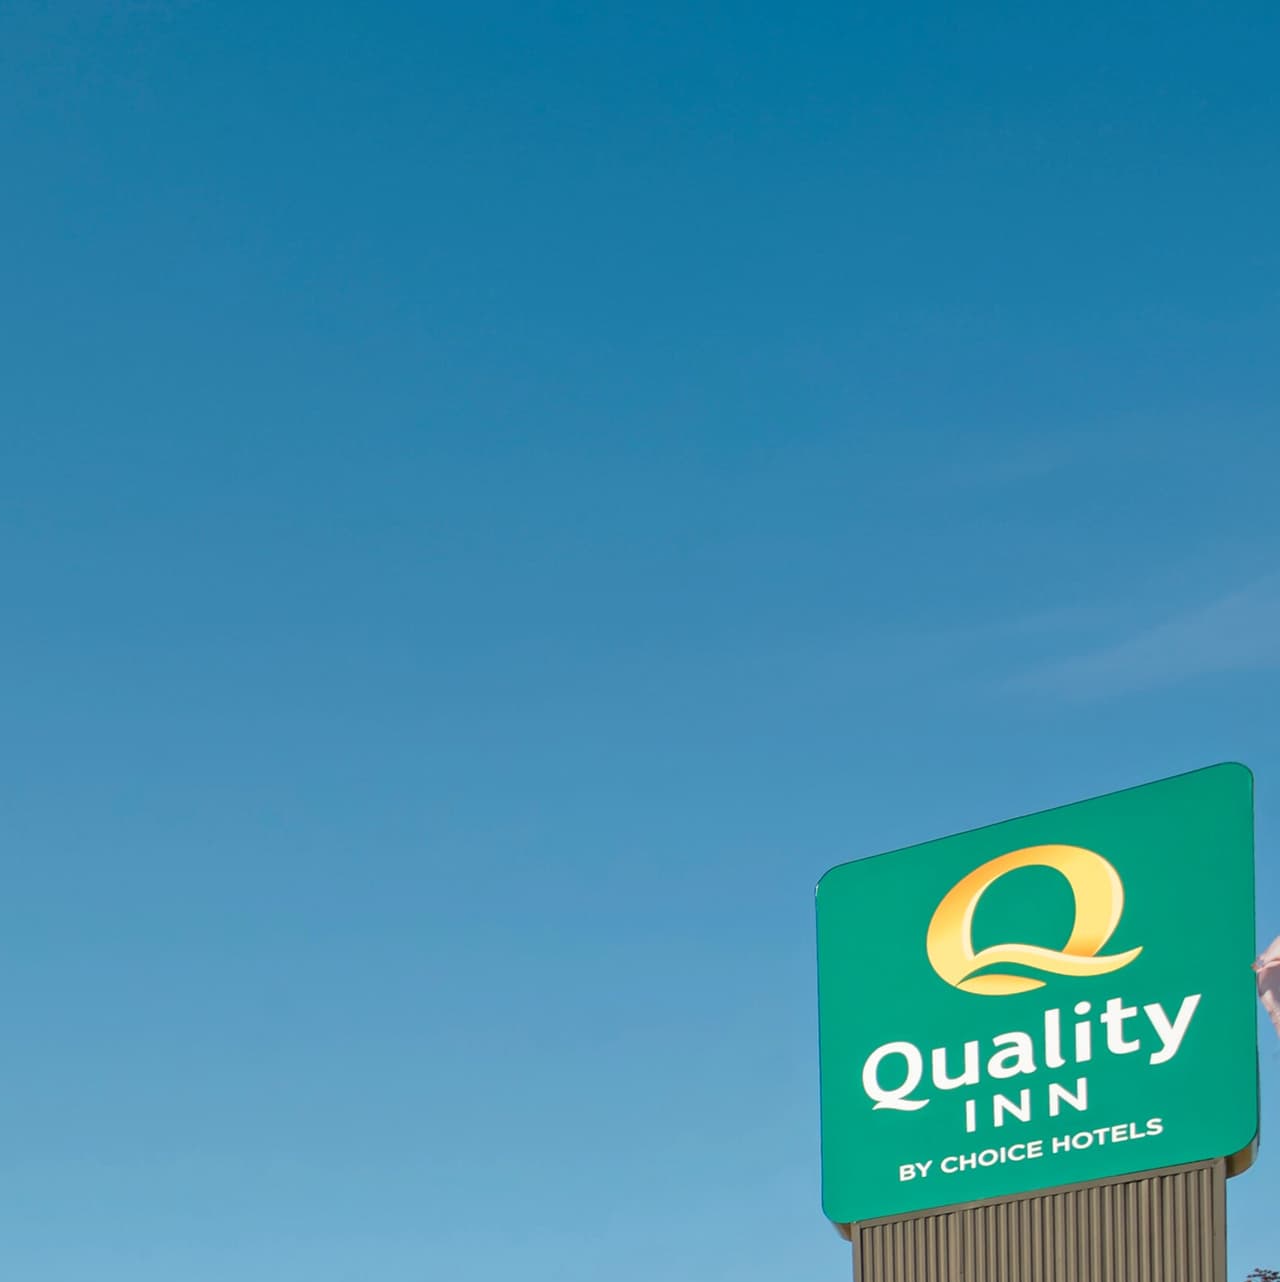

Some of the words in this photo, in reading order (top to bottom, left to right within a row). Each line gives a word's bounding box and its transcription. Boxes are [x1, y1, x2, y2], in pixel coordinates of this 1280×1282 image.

[926, 844, 1143, 996] Q
[861, 994, 1202, 1111] Quality
[899, 1160, 933, 1182] BY
[940, 1140, 1044, 1174] CHOICE
[1051, 1117, 1164, 1154] HOTELS
[965, 1077, 1089, 1133] INN
